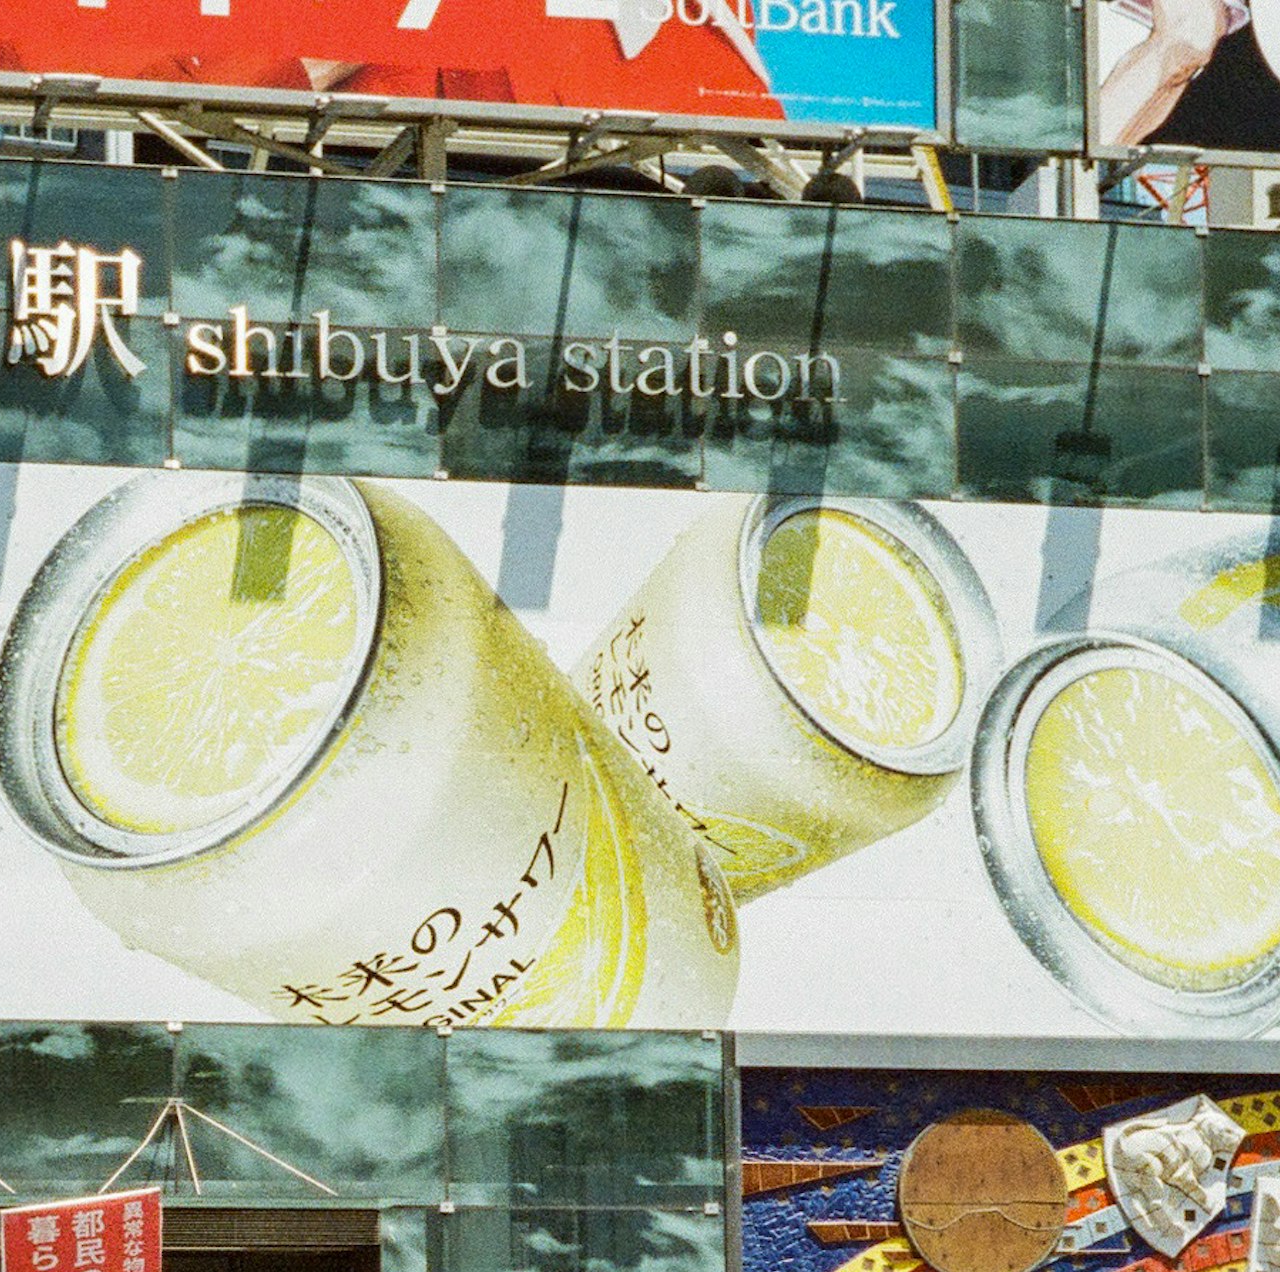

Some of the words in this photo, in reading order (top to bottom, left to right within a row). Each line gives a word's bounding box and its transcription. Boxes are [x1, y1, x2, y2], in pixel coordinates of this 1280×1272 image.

[184, 303, 534, 396] shibuya
[563, 331, 845, 403] station
[272, 907, 462, 1008] 未来の
